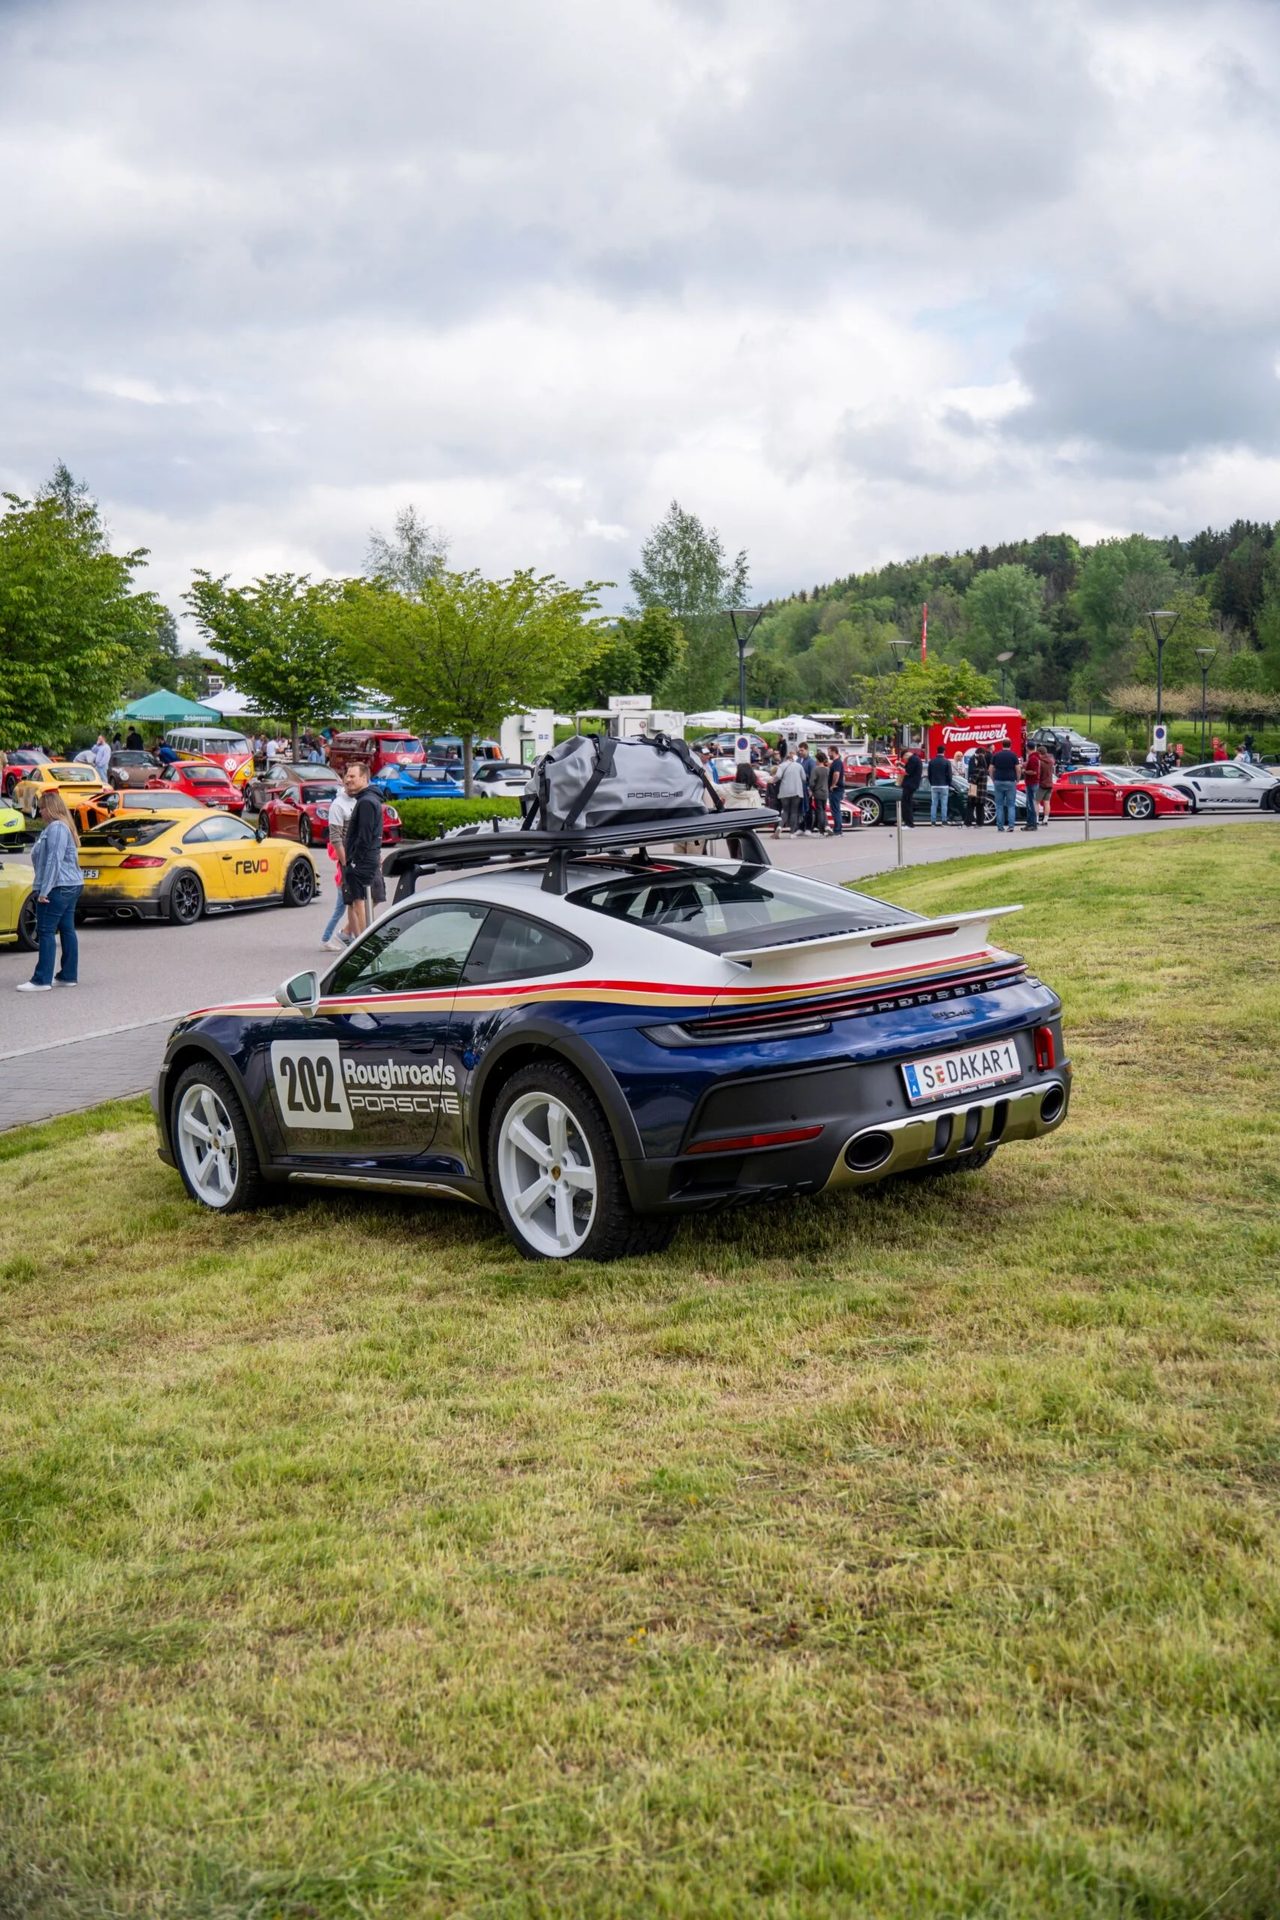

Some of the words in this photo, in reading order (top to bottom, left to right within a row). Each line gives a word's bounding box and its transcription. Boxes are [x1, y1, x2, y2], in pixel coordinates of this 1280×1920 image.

[942, 723, 1008, 744] Traumwerk
[627, 790, 684, 799] PORSCHE
[235, 858, 269, 875] revo
[877, 980, 997, 1012] PORSCHE
[343, 1058, 456, 1090] Roughroads
[922, 1064, 936, 1089] S
[945, 1049, 1003, 1084] DAKAR
[1003, 1046, 1014, 1069] 1
[280, 1056, 342, 1113] 202
[911, 1084, 918, 1094] A
[348, 1096, 461, 1115] PORSCHE
